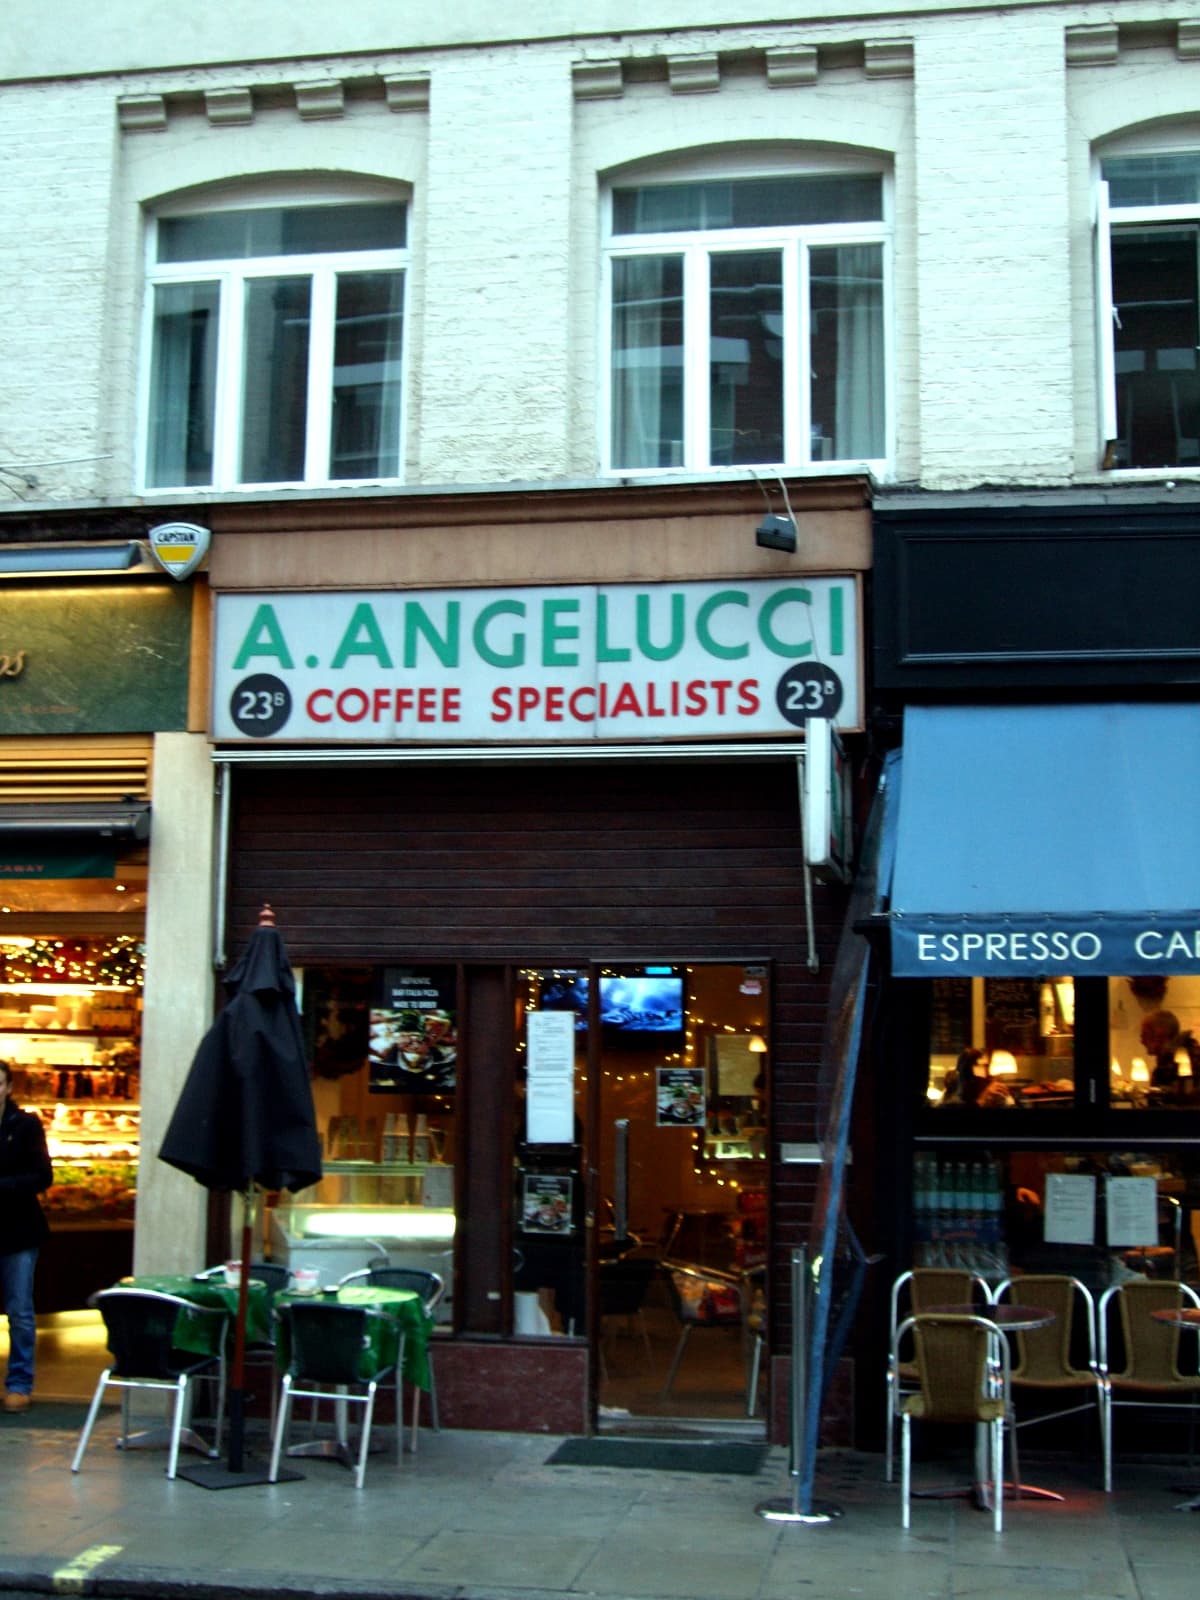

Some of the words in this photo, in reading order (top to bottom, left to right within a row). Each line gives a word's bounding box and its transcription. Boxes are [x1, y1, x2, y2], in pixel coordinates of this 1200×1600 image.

[306, 687, 461, 723] COFFEE
[490, 678, 760, 723] SPECIALISTS
[918, 931, 1102, 961] ESPRESSO
